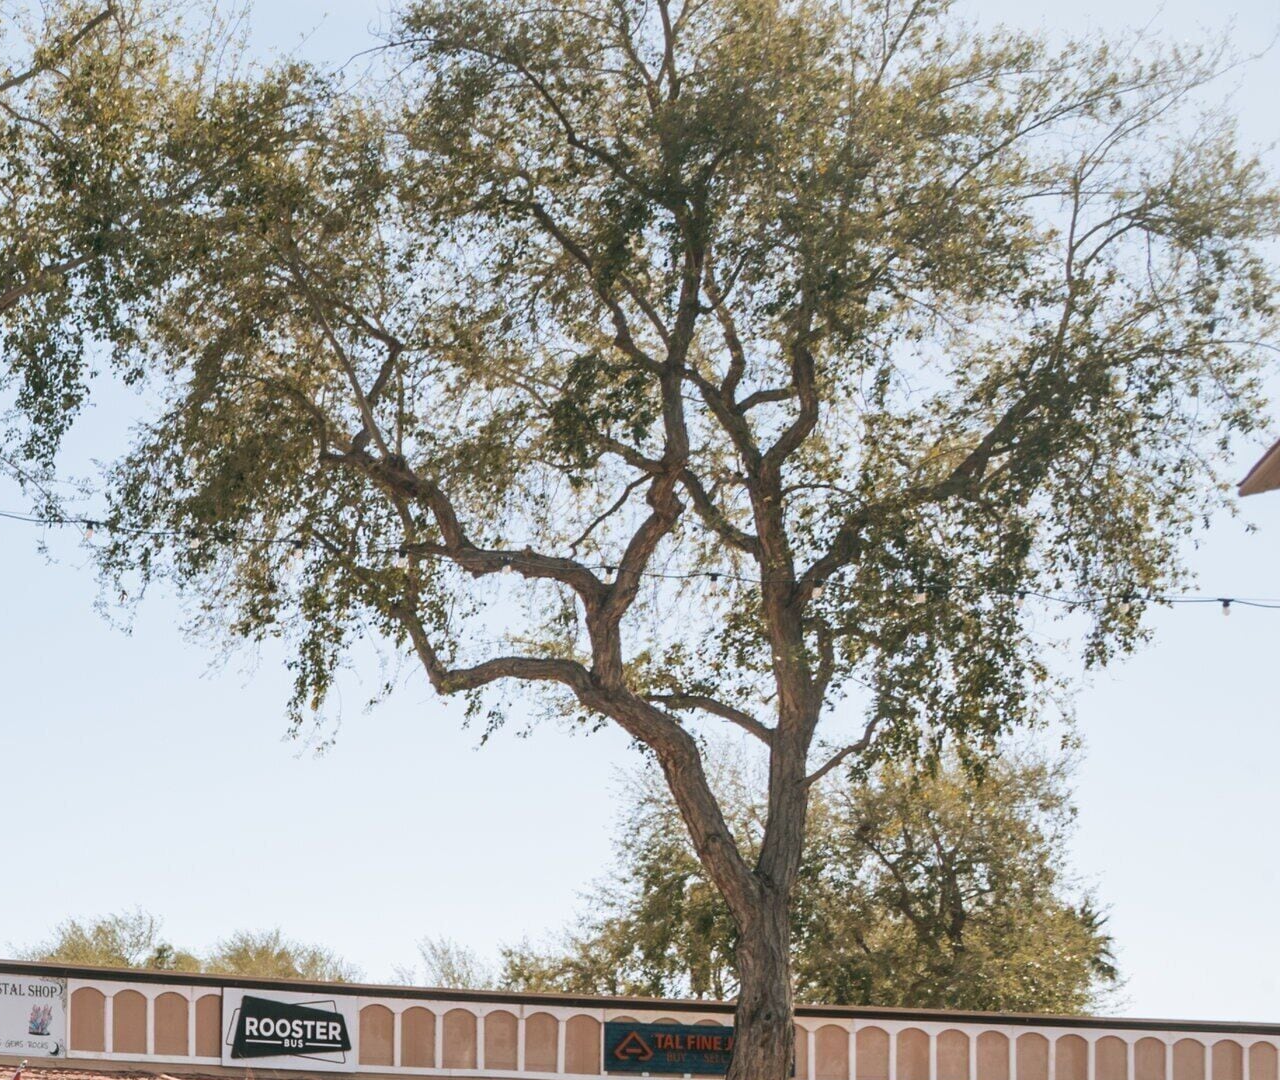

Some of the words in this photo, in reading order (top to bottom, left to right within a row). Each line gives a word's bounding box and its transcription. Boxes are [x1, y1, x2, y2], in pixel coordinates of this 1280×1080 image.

[27, 984, 58, 999] SHOP
[244, 1016, 342, 1041] ROOSTER
[4, 1039, 24, 1049] GEMS
[283, 1039, 304, 1048] BUS
[654, 1033, 683, 1049] TAL
[687, 1034, 722, 1050] FINE
